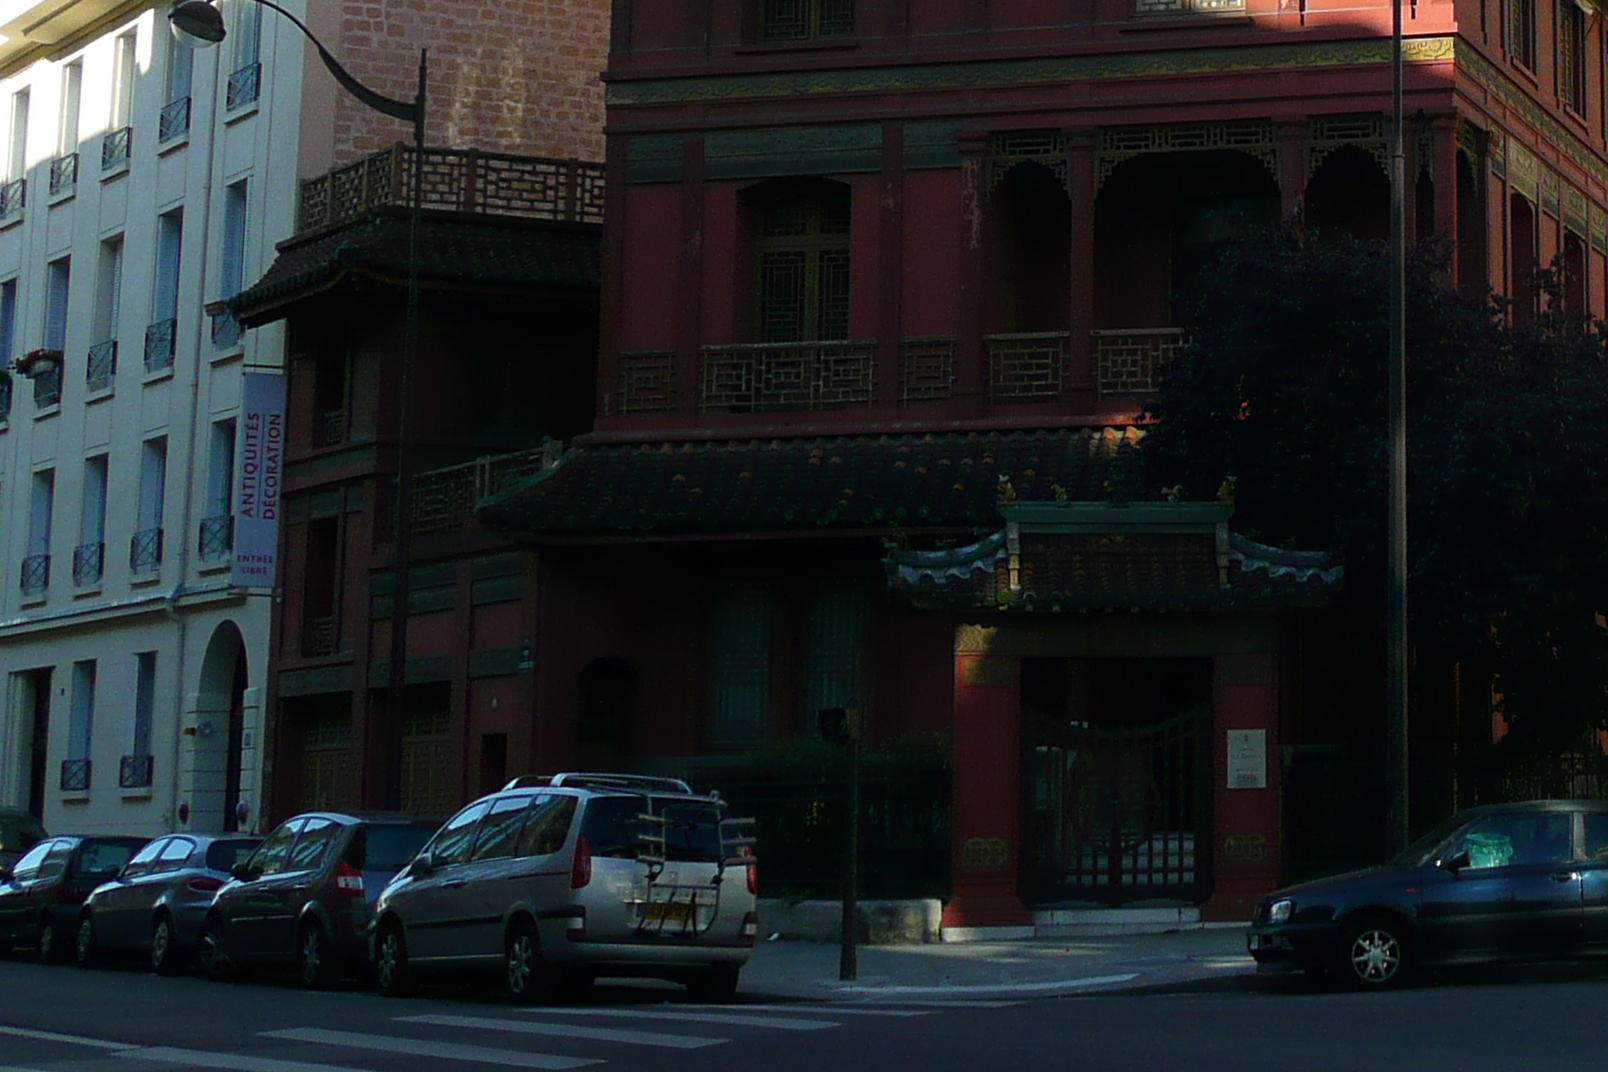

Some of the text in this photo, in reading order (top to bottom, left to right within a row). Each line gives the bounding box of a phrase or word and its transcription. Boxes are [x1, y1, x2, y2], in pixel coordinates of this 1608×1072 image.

[241, 412, 260, 518] ANTIQUITÉS
[263, 413, 282, 520] DÉCORATION
[237, 554, 273, 564] ENTRÉE
[241, 565, 268, 575] LIBRE
